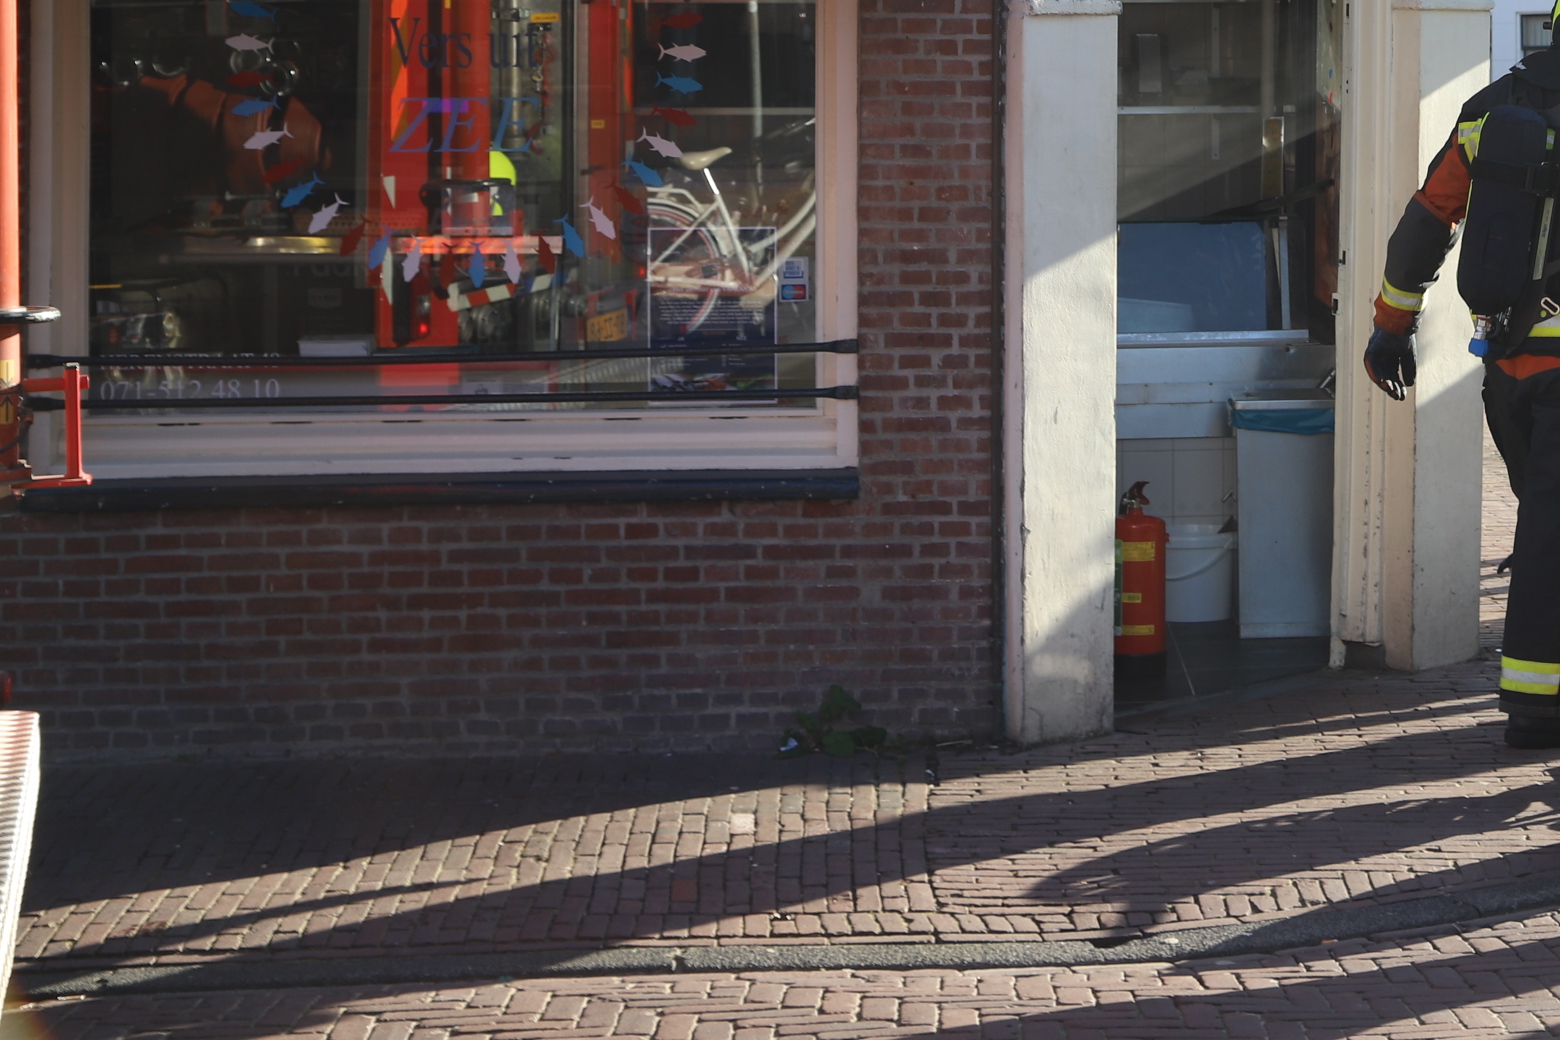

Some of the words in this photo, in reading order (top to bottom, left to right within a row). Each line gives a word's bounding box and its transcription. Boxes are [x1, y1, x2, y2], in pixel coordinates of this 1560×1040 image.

[386, 17, 473, 69] Vers
[387, 96, 542, 153] ZEE
[210, 379, 241, 400] 48
[253, 378, 280, 400] 10
